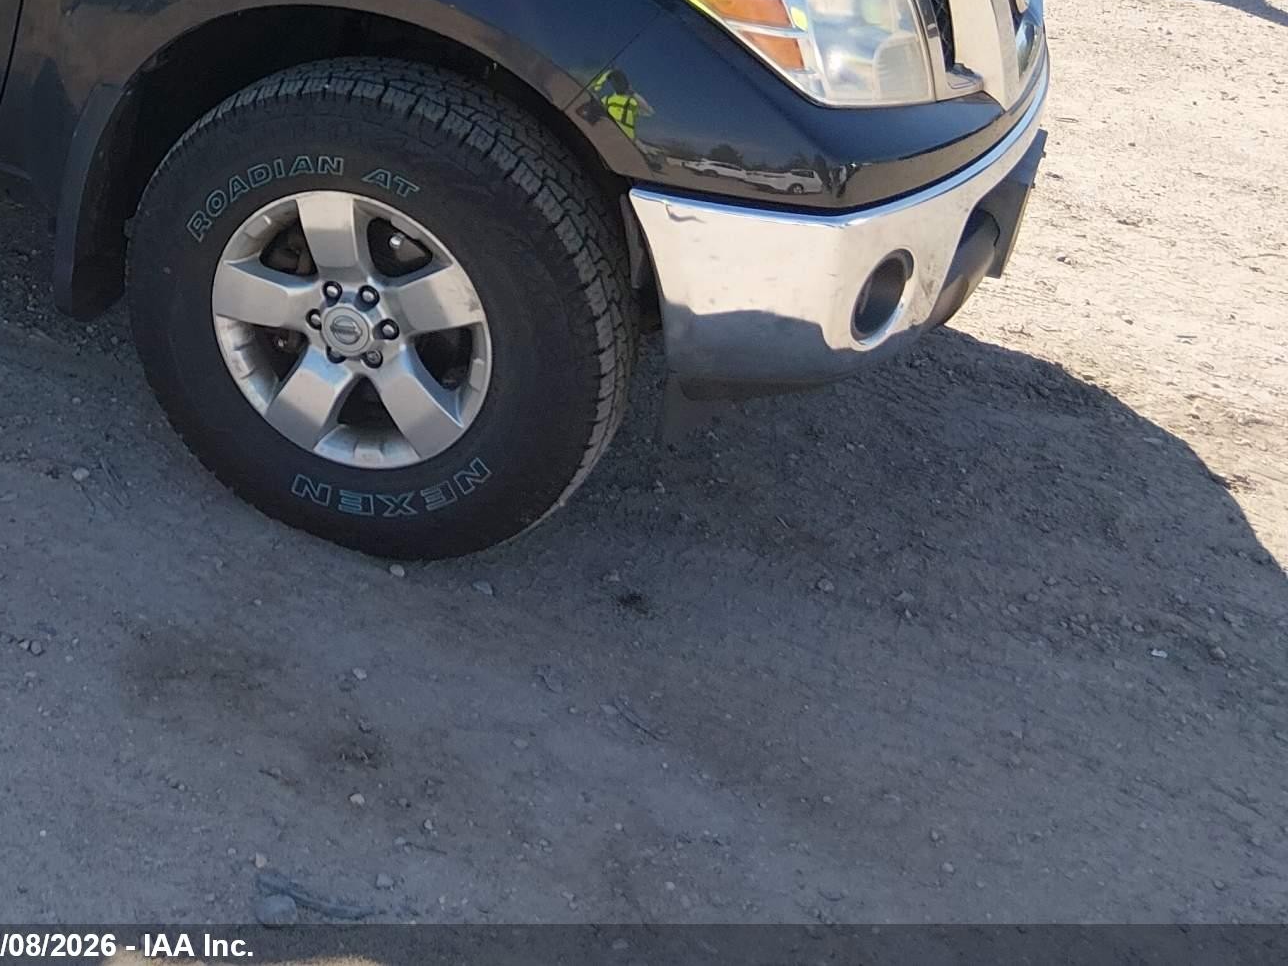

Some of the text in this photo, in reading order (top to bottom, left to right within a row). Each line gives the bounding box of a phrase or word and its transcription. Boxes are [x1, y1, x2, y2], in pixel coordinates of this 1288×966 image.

[186, 156, 421, 242] ROADIAN AT
[291, 457, 493, 517] NEXEN
